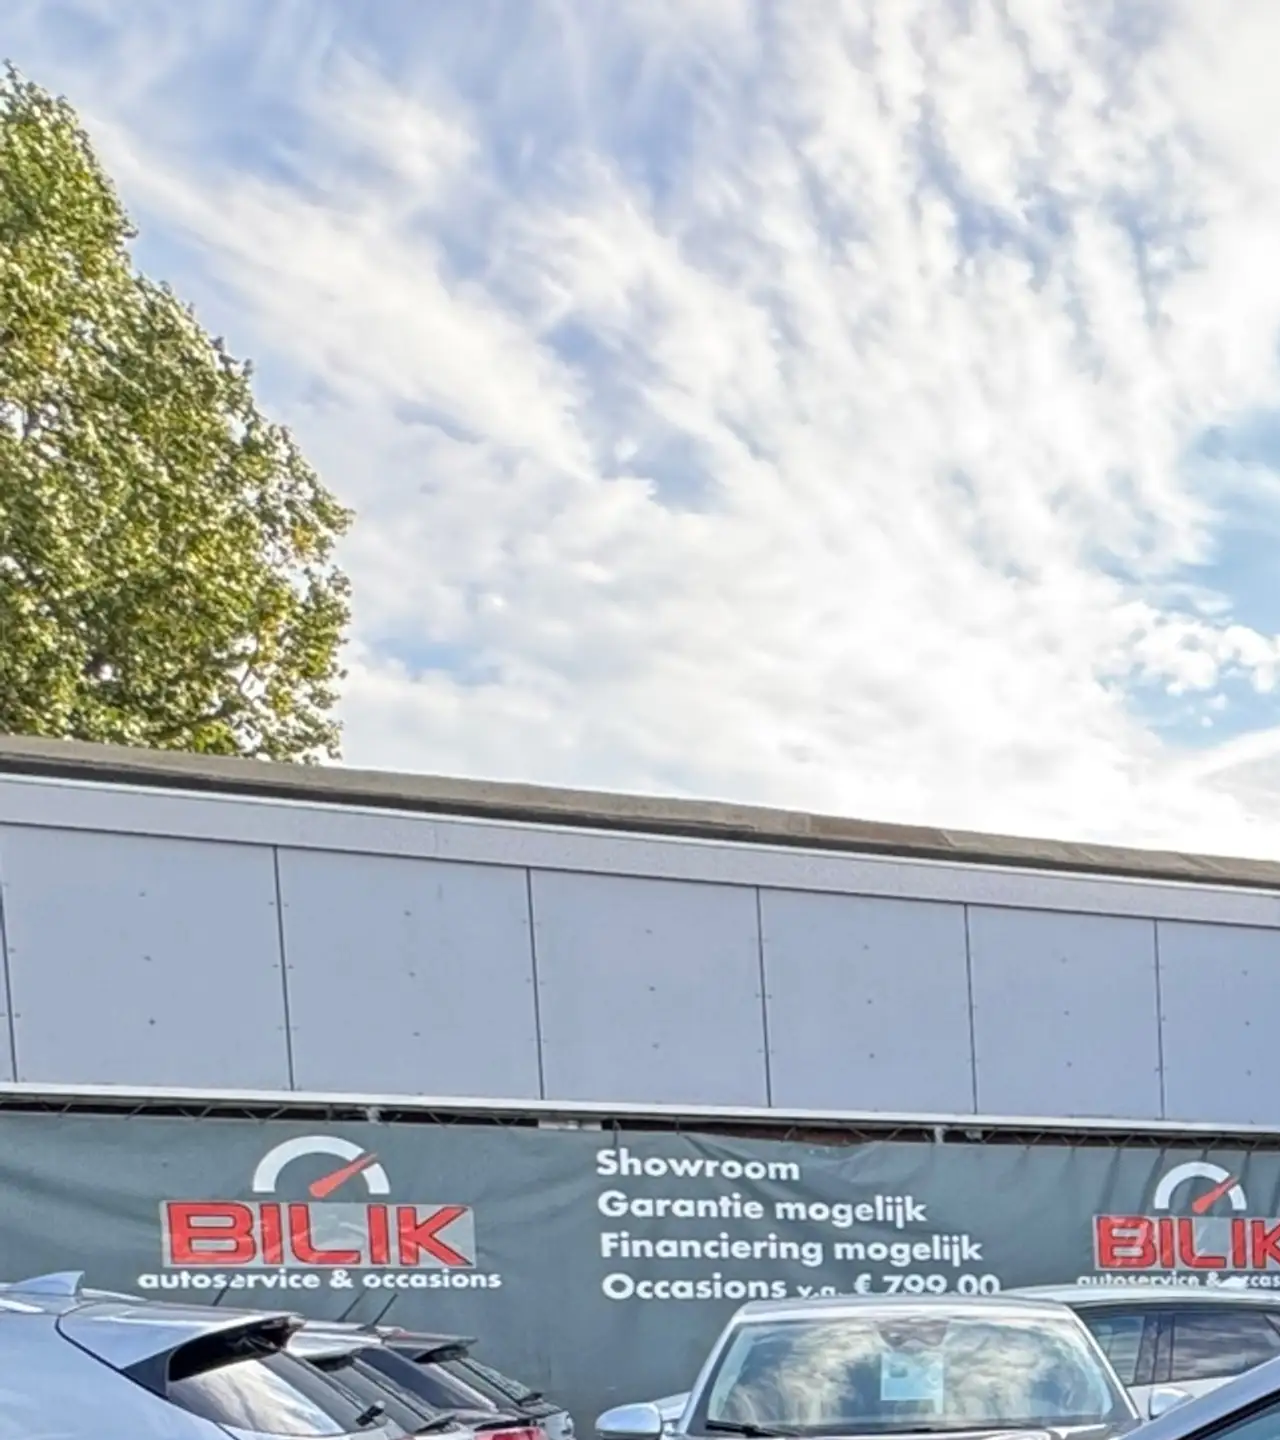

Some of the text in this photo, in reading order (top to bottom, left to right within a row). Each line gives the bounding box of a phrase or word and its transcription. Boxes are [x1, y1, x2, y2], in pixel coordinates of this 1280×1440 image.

[596, 1148, 799, 1180] Showroom
[598, 1191, 928, 1228] Garantie mogelijk
[166, 1201, 473, 1267] BILIK
[601, 1233, 983, 1267] Financiering mogelijk
[138, 1269, 502, 1289] autoservice & occasions
[602, 1272, 787, 1300] Occasions
[854, 1273, 872, 1296] €
[1206, 1272, 1222, 1287] &
